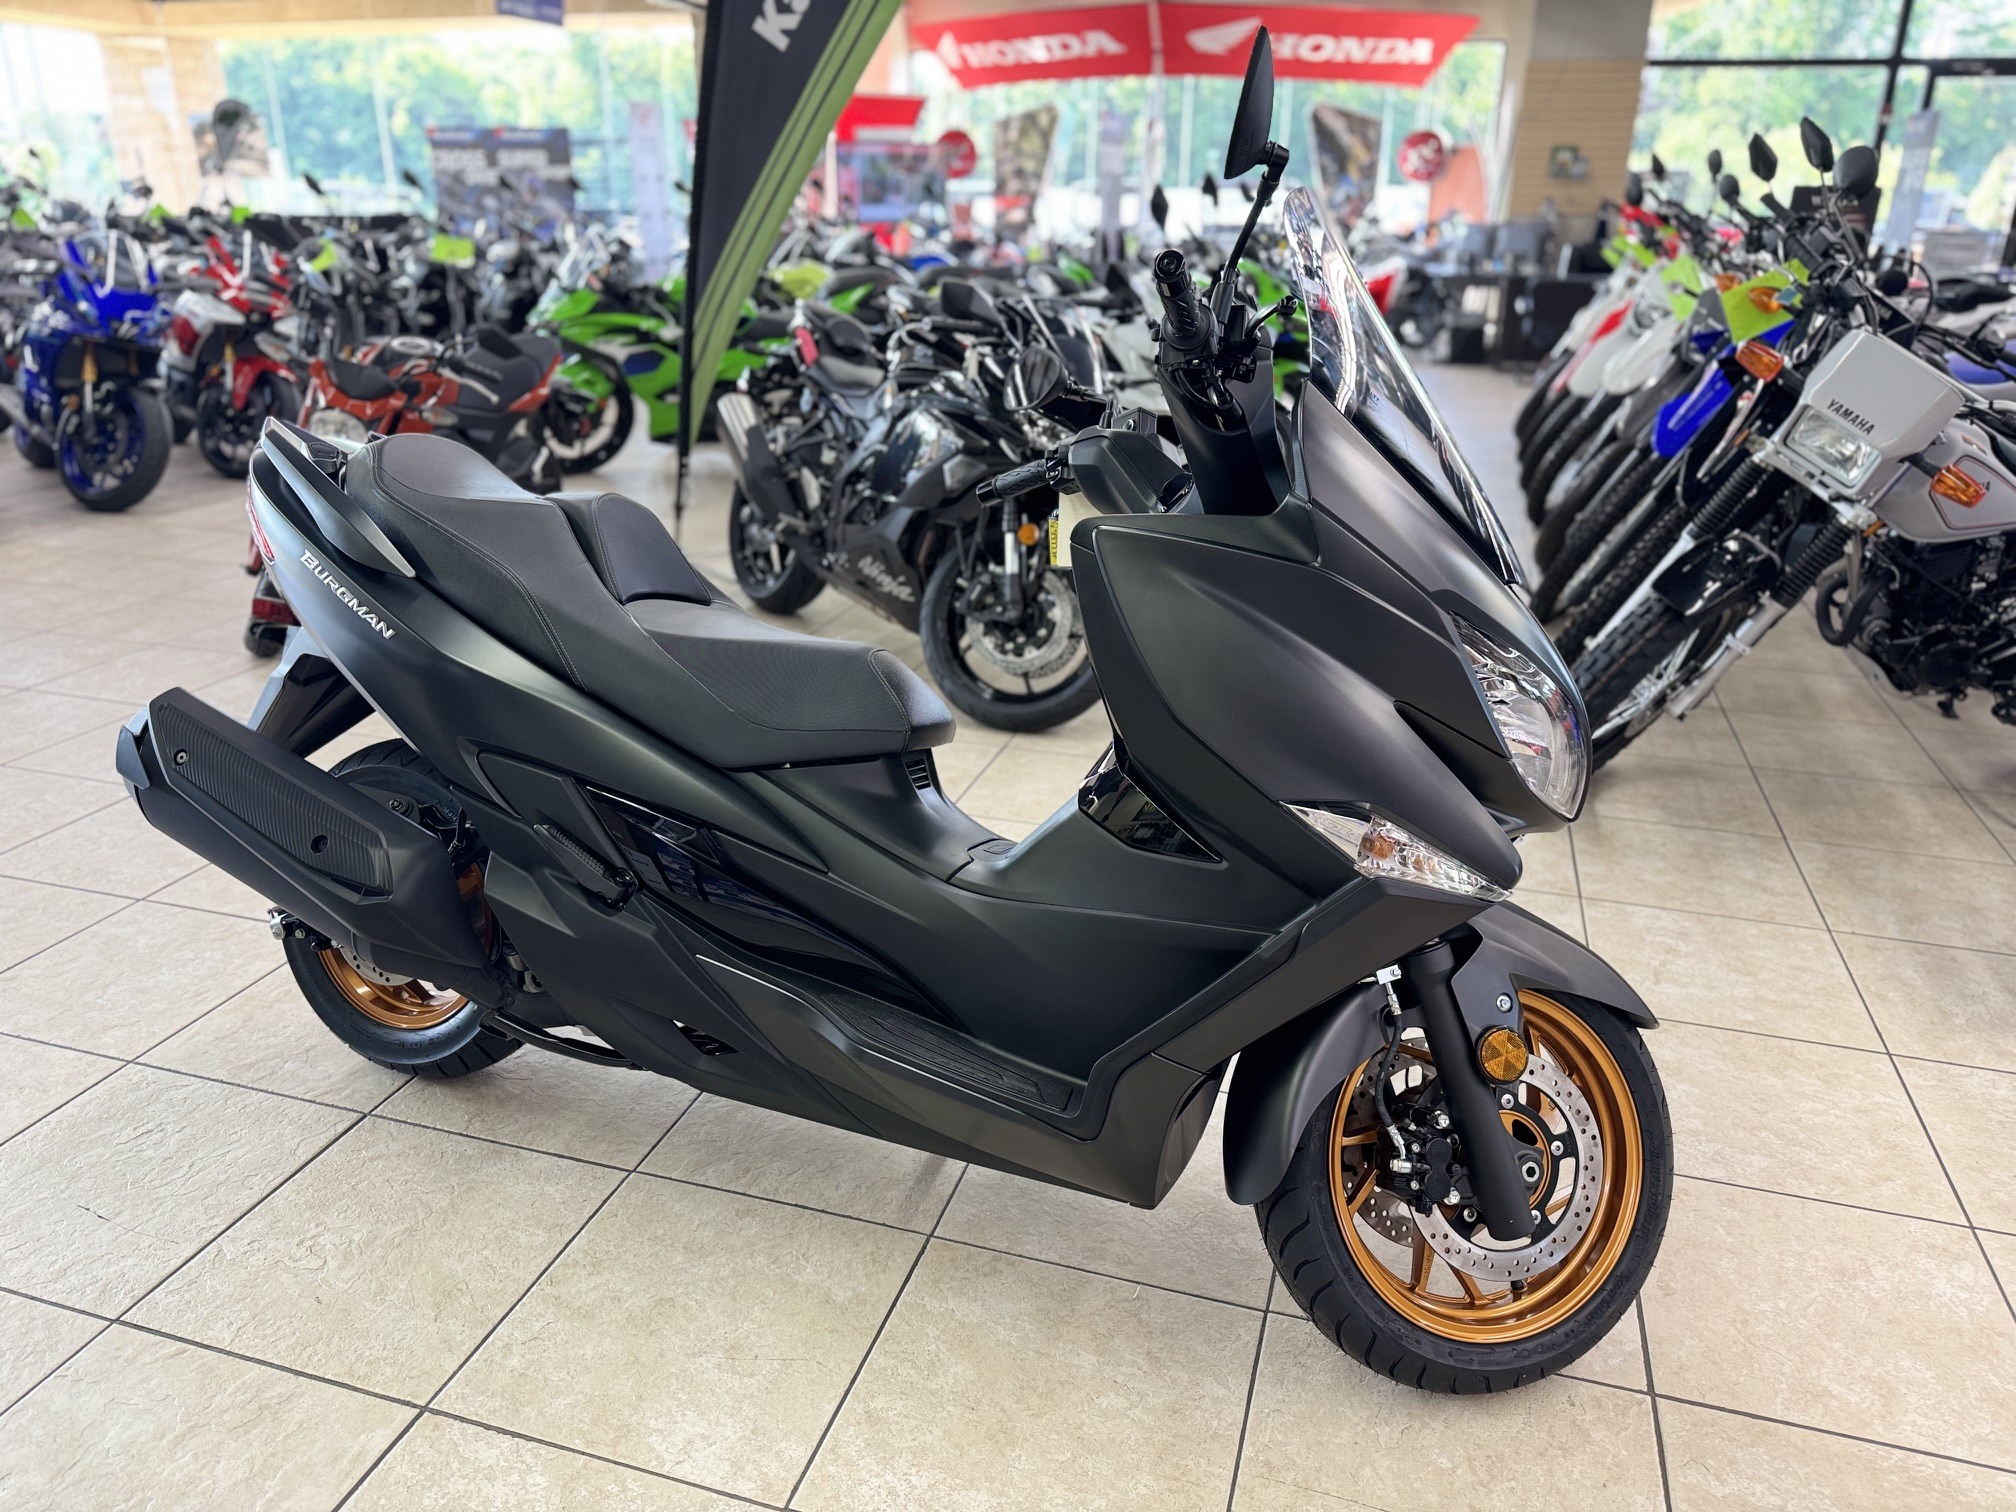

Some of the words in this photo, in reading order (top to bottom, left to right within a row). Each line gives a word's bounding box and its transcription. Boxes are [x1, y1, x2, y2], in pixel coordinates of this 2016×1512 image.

[960, 29, 1128, 69] HONDA
[1270, 32, 1435, 65] HONDA
[1827, 399, 1876, 436] YAMAHA
[299, 548, 396, 640] BURGMAN
[857, 555, 916, 603] Ninja
